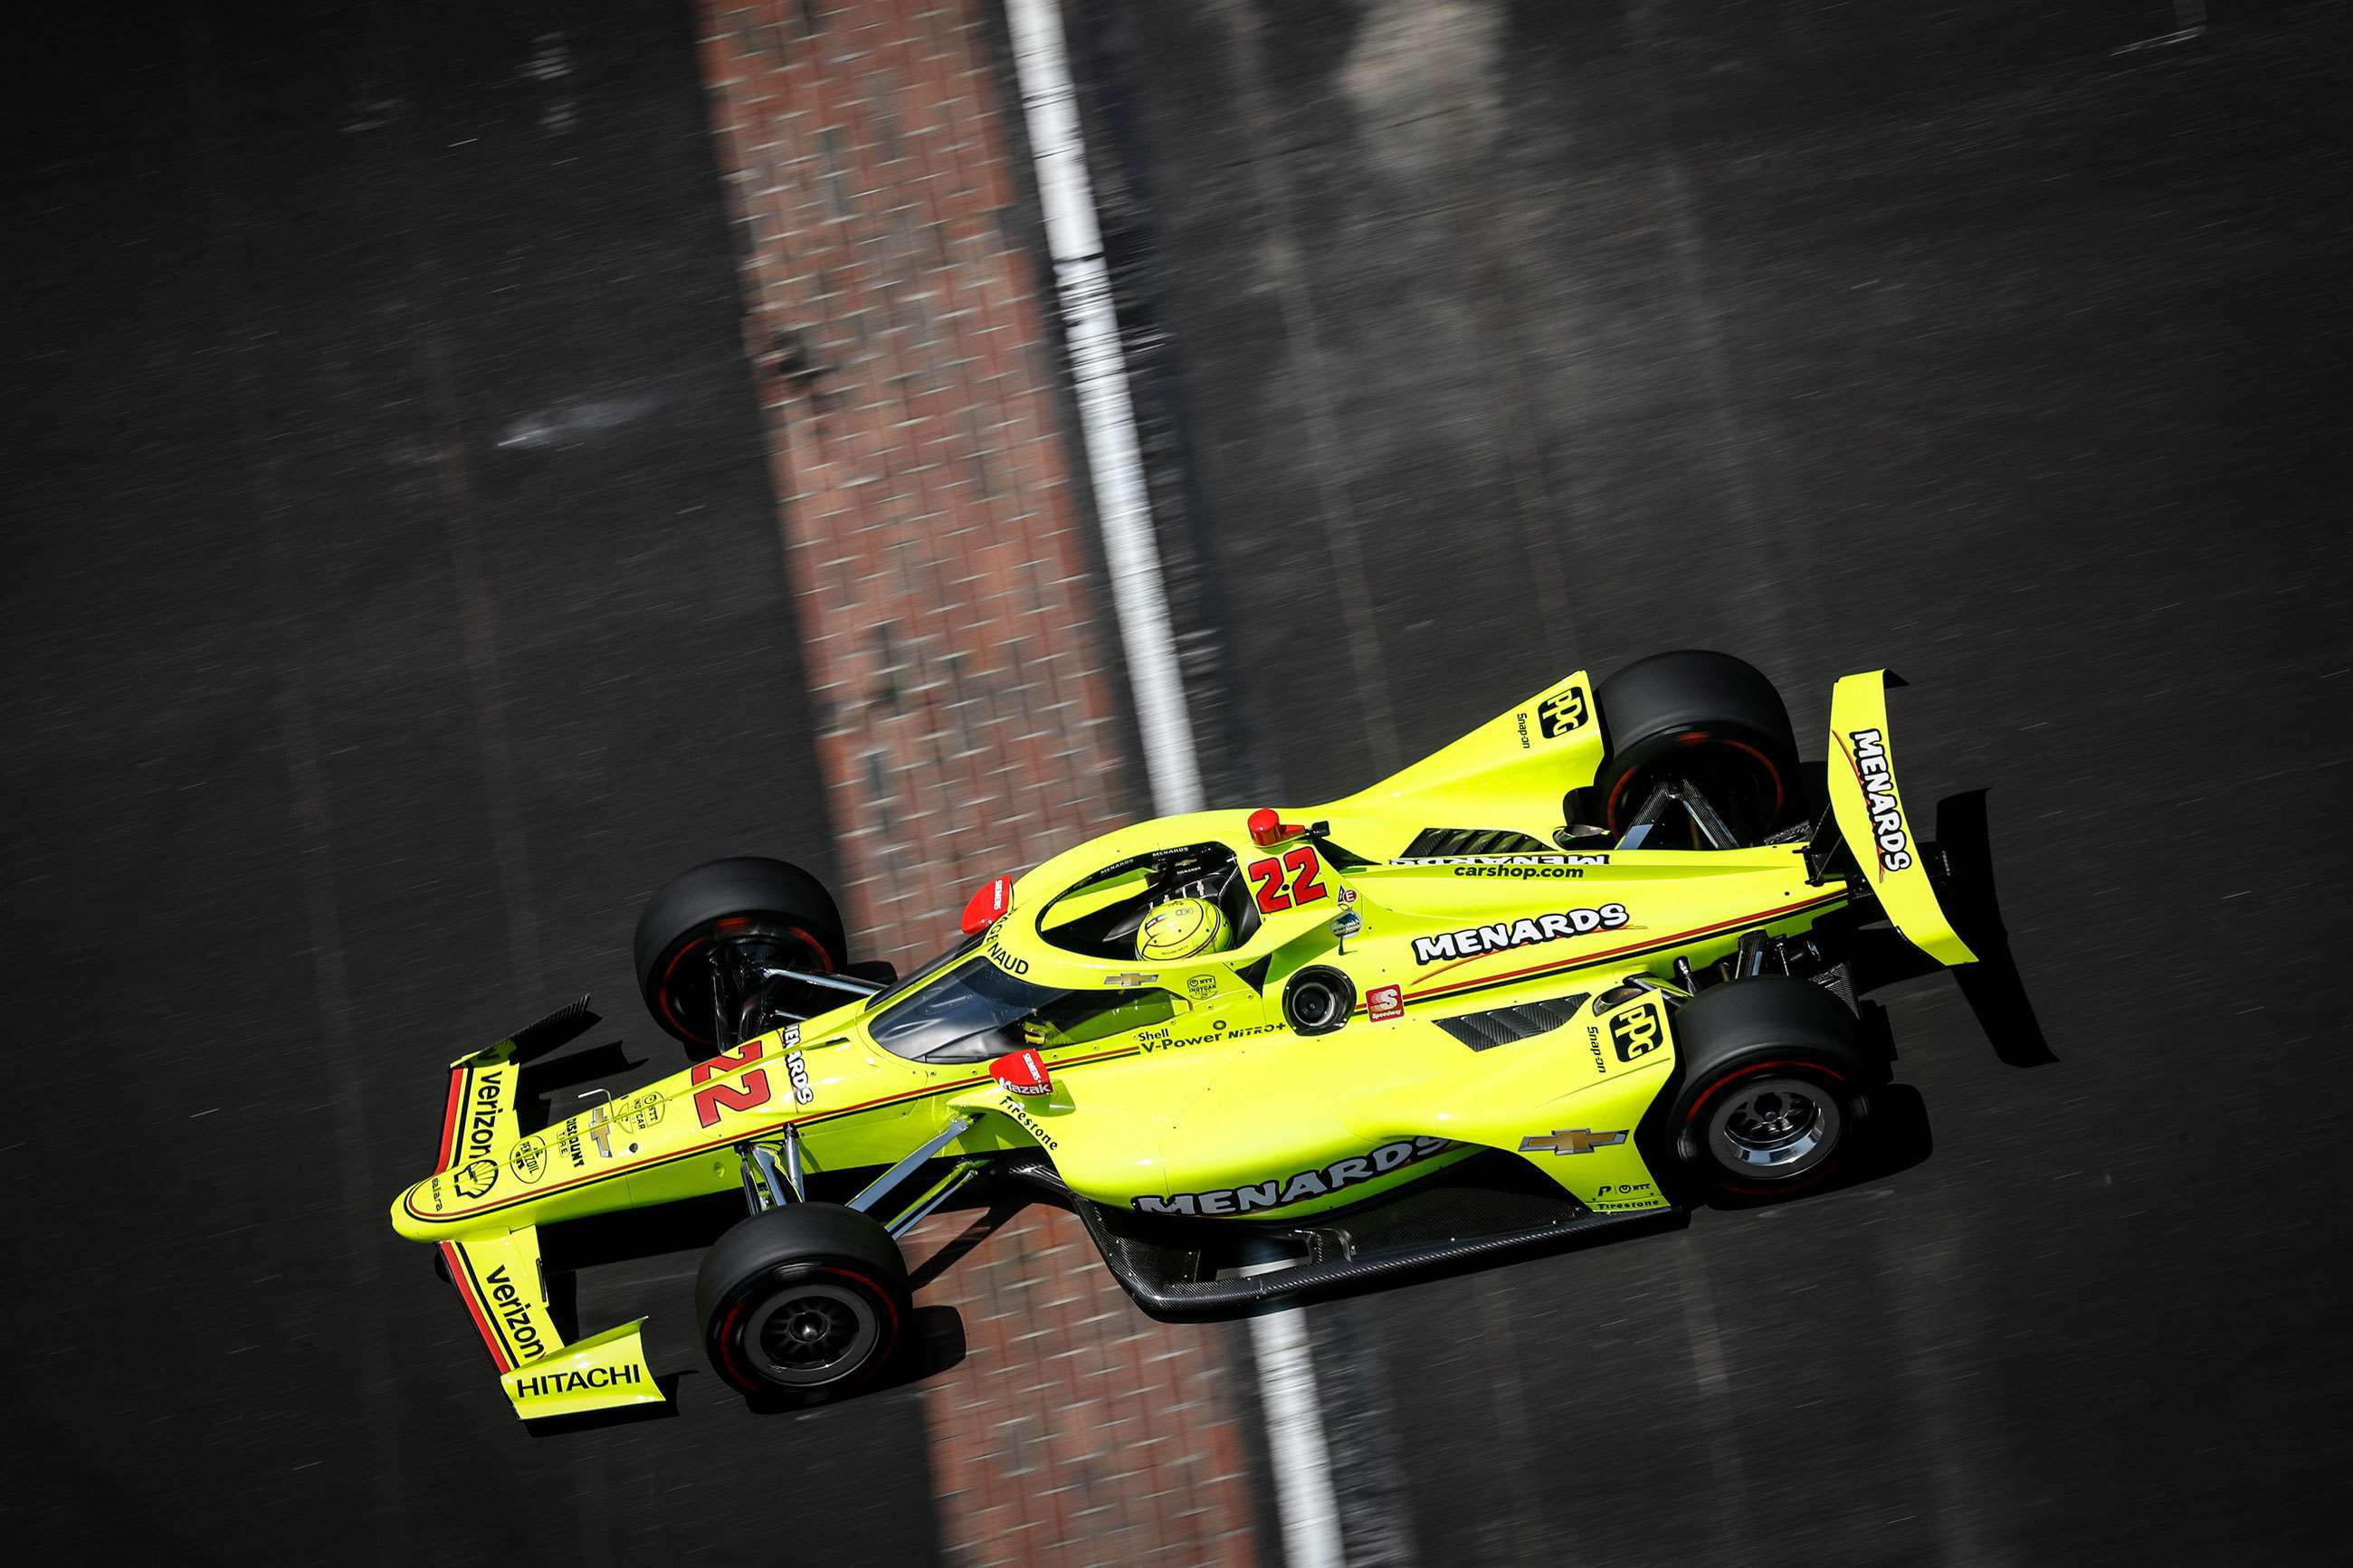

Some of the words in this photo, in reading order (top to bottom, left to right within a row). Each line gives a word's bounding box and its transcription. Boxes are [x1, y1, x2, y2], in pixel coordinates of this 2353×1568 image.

[1541, 689, 1583, 736] PPG
[1849, 728, 1911, 871] MENARDS
[1100, 859, 1134, 875] MENARDS
[1248, 846, 1329, 914] 22
[1453, 865, 1584, 879] carshop.com
[987, 908, 1029, 974] AGENAUD
[1411, 903, 1629, 965] MENARDS
[1138, 1028, 1169, 1041] Shell
[1141, 1032, 1223, 1053] V-Power
[1614, 1005, 1657, 1060] PPG
[691, 1041, 771, 1128] 22
[999, 1077, 1052, 1094] Mazak
[469, 1070, 503, 1159] verizon
[634, 1098, 646, 1130] INDCAR
[999, 1096, 1058, 1150] Firestone
[1133, 1136, 1452, 1216] MENARDS
[1598, 1200, 1659, 1211] Firestone
[486, 1264, 546, 1358] verizon
[516, 1364, 642, 1398] HITACHI
